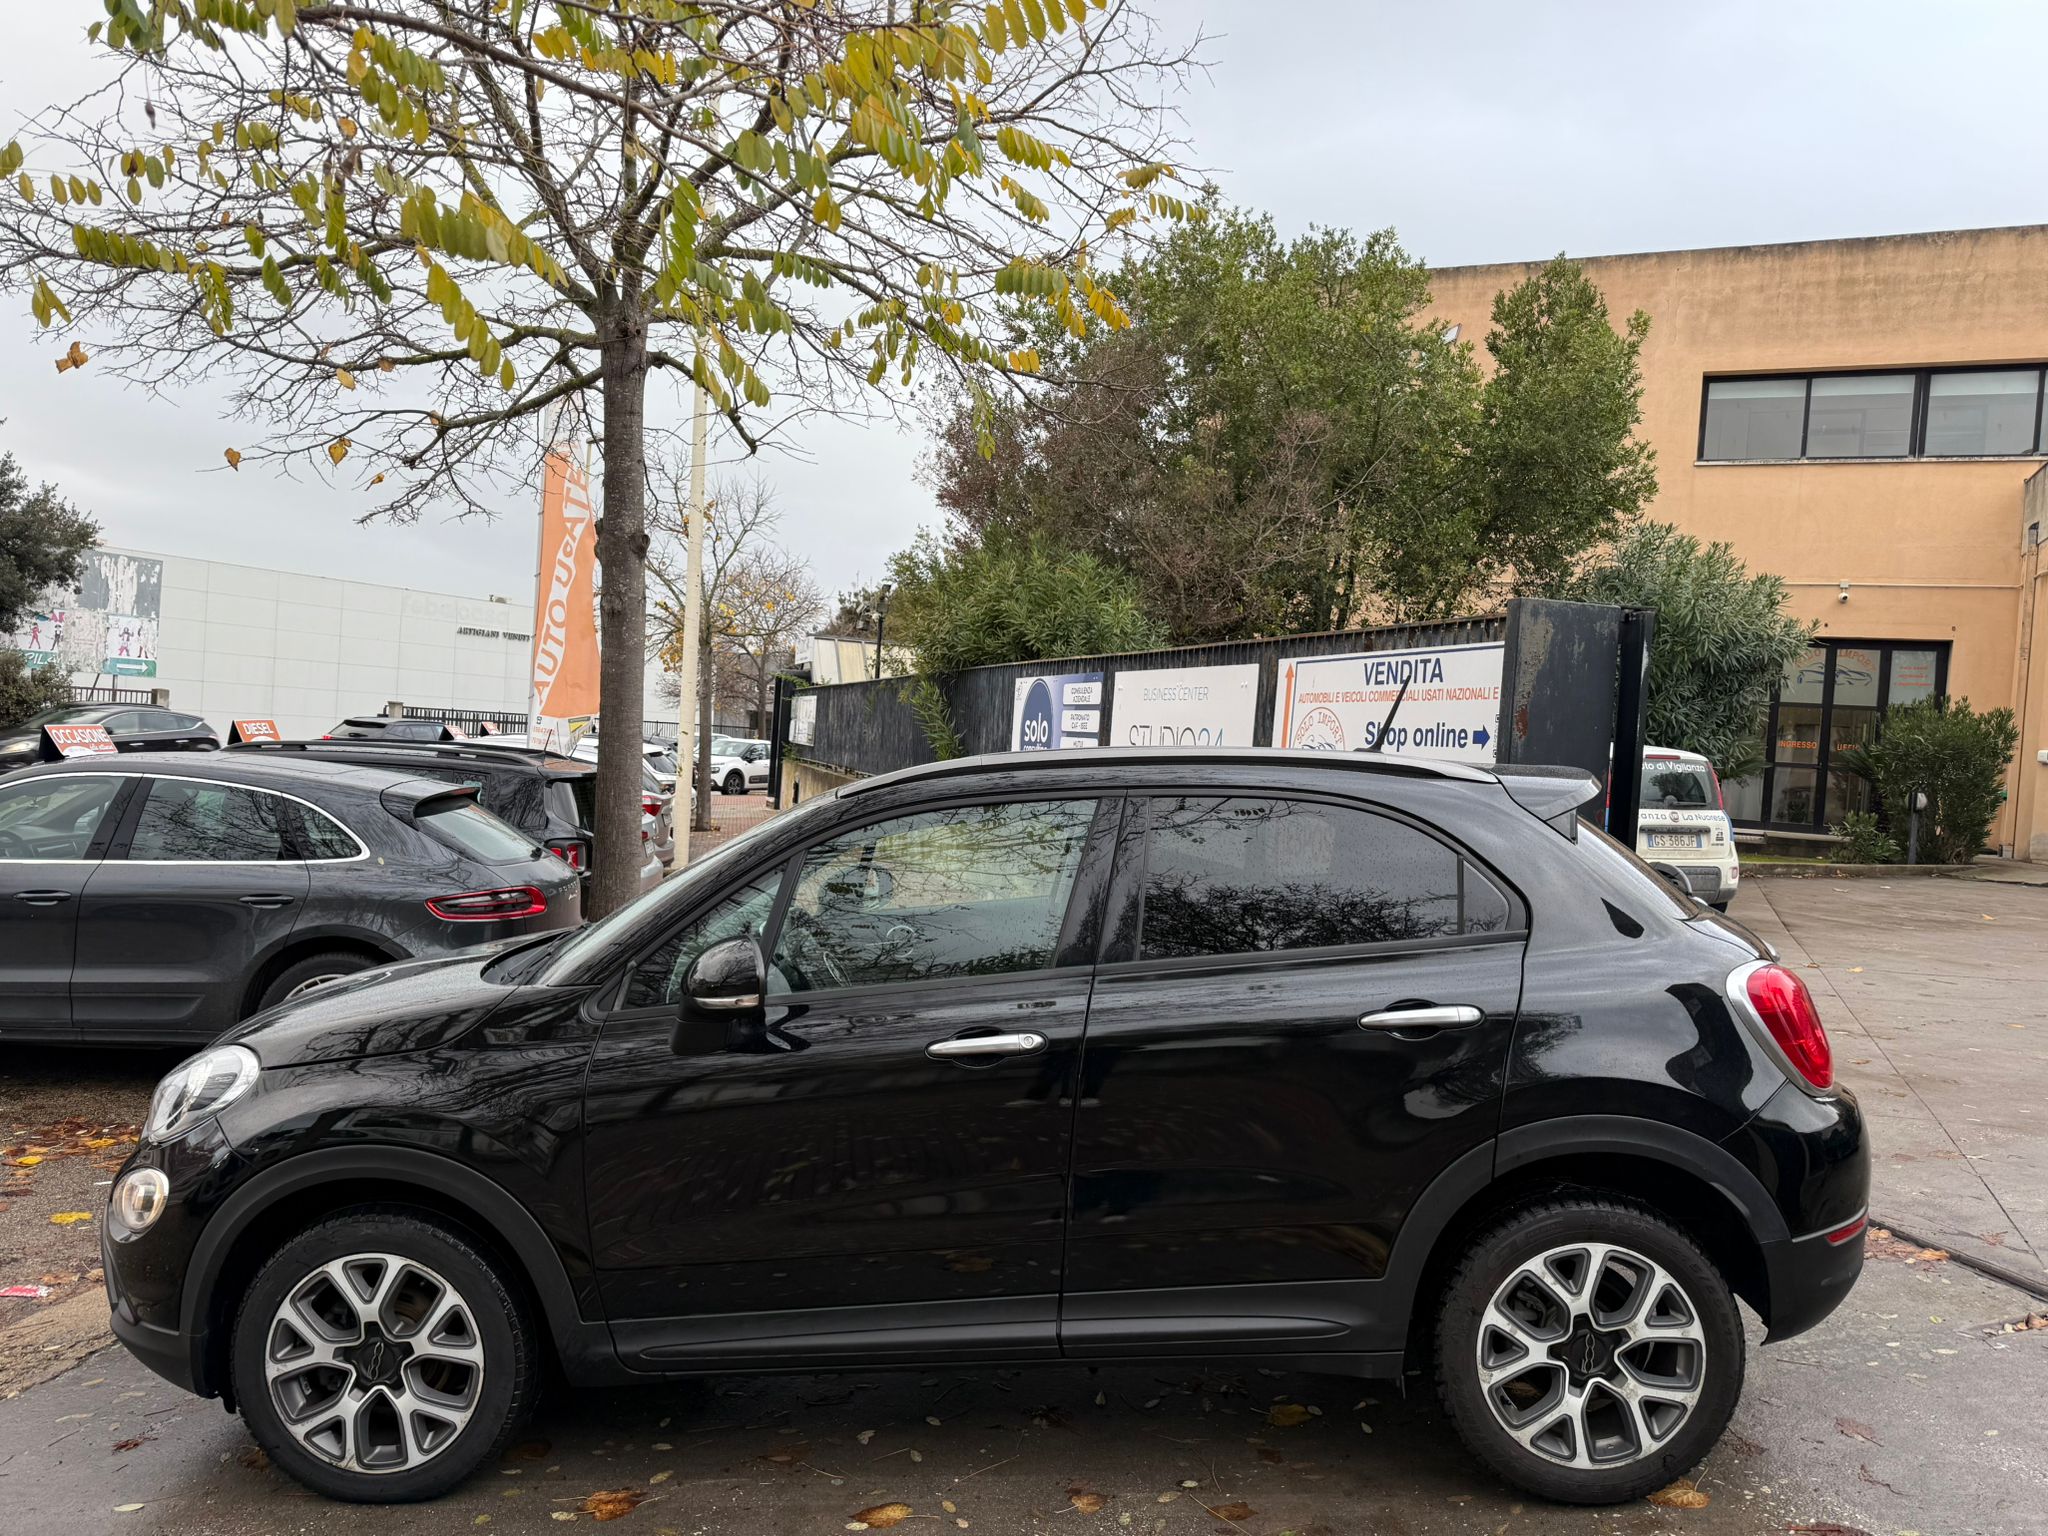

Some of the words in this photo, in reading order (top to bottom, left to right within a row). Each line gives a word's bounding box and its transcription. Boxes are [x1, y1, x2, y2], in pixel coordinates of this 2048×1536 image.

[533, 599, 566, 706] AUTO
[1363, 658, 1444, 686] VENDITA
[1143, 687, 1177, 701] BUSINESS
[1177, 686, 1209, 701] CENTER
[1298, 691, 1334, 704] AUTOMOBILI
[1335, 691, 1341, 703] E
[1341, 691, 1368, 703] VEICOLI
[1421, 688, 1444, 701] USATI
[1446, 687, 1491, 701] NAZIONALI
[1492, 686, 1499, 700] E
[51, 728, 110, 744] OCCASIONE
[242, 722, 274, 735] DIESEL
[1024, 712, 1049, 743] solo
[1297, 715, 1314, 745] SOLO
[1317, 711, 1343, 744] IMPORT
[1413, 722, 1468, 749] online
[1656, 762, 1665, 770] di
[1665, 761, 1706, 773] Vigilanza
[1653, 834, 1666, 847] GS
